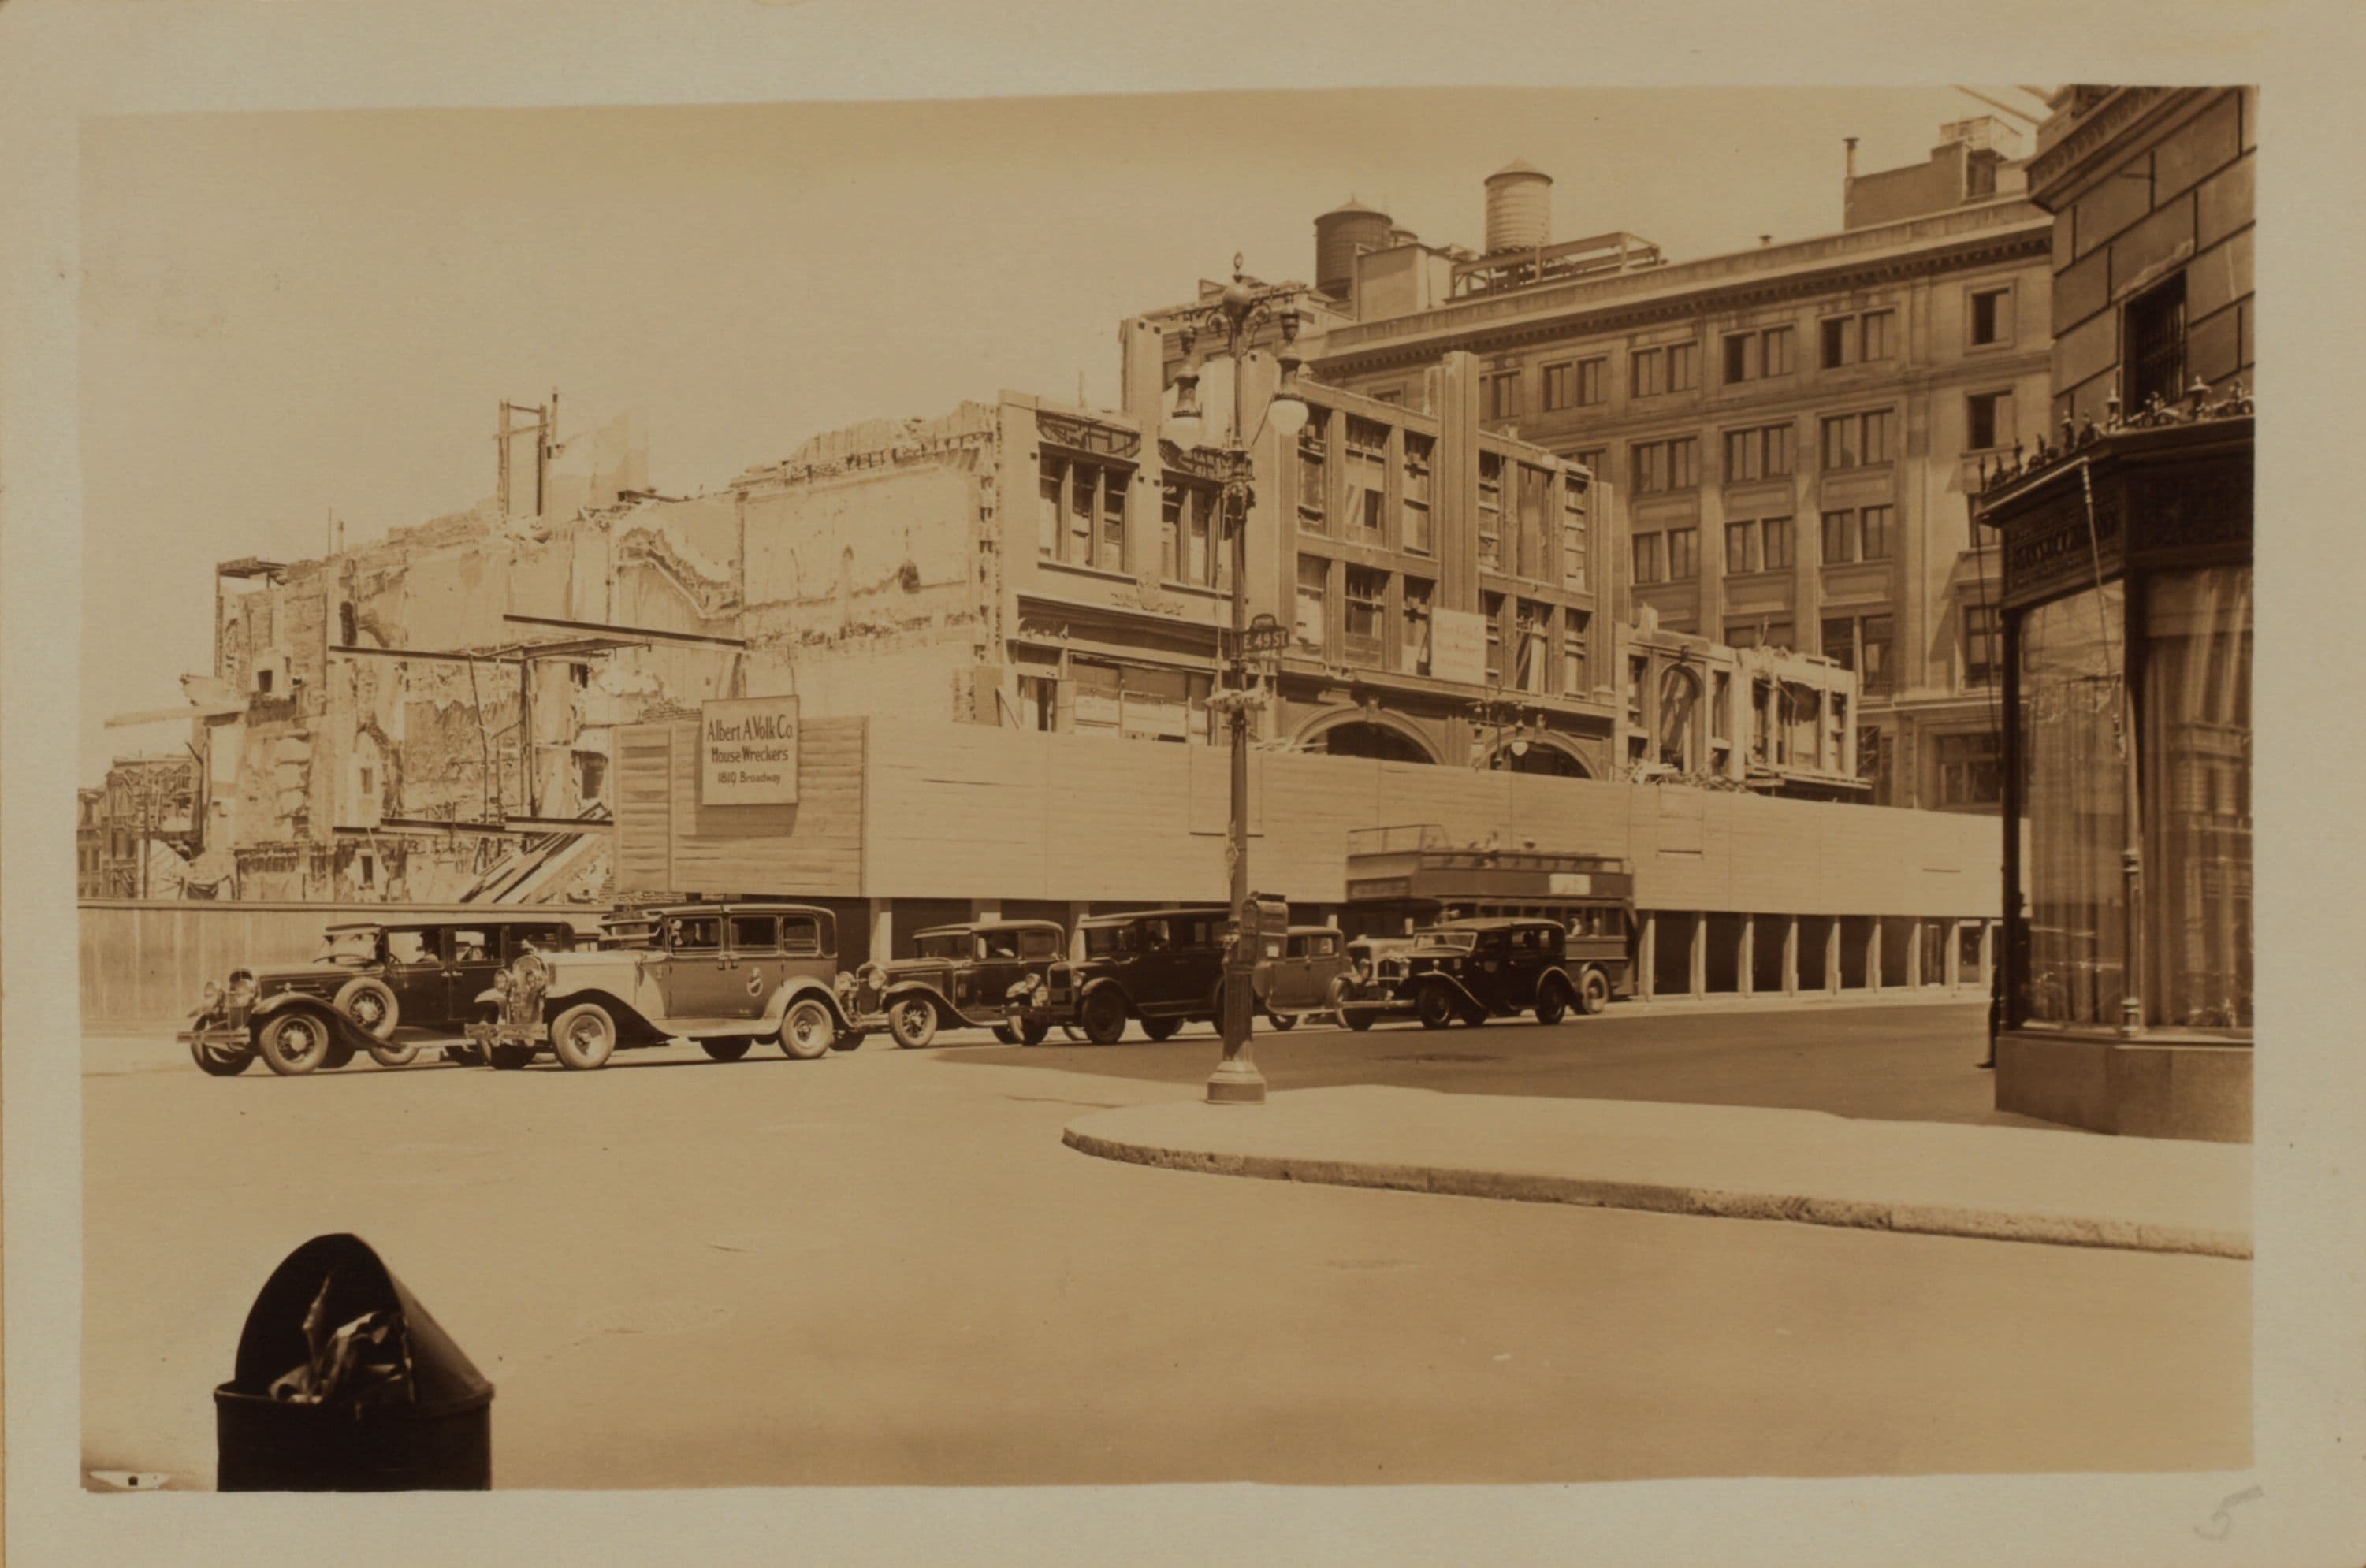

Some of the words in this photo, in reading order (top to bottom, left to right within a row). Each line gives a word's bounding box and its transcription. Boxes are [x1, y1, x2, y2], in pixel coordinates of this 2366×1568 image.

[1244, 634, 1252, 649] E
[1255, 631, 1270, 649] 49
[1273, 630, 1286, 647] ST
[707, 718, 741, 741] Albert
[752, 715, 776, 740] Volk
[712, 747, 741, 763] House
[742, 745, 788, 762] Wreckers
[740, 771, 780, 786] Broadway
